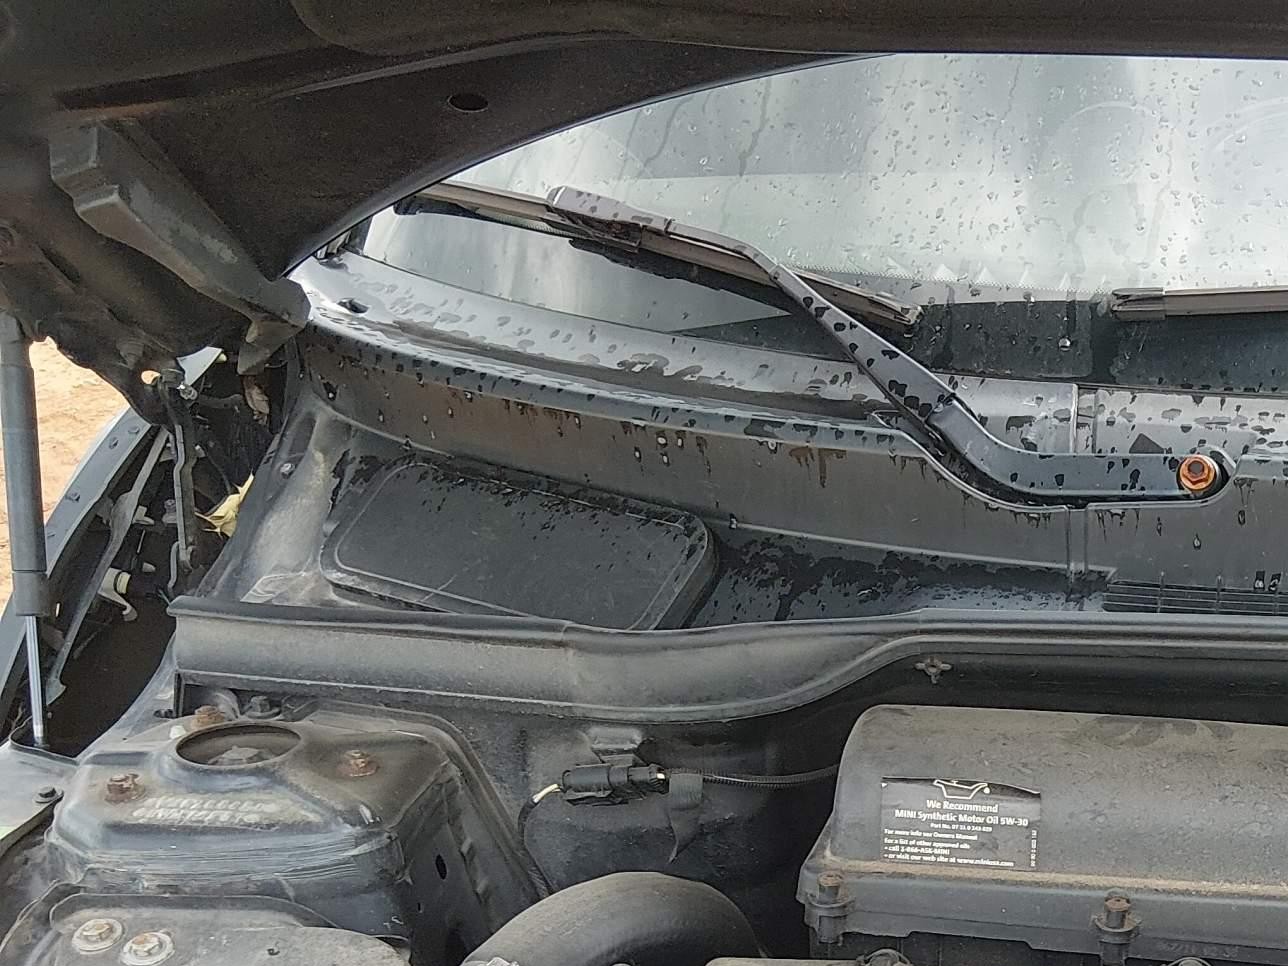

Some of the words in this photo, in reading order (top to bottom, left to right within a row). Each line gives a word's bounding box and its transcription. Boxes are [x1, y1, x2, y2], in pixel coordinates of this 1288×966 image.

[926, 799, 942, 809] We
[943, 800, 998, 813] Recommend
[895, 809, 917, 818] MINI
[917, 811, 957, 821] Synthetic
[958, 814, 985, 823] Motor
[985, 816, 999, 825] Oil
[1000, 817, 1029, 826] 5W-30
